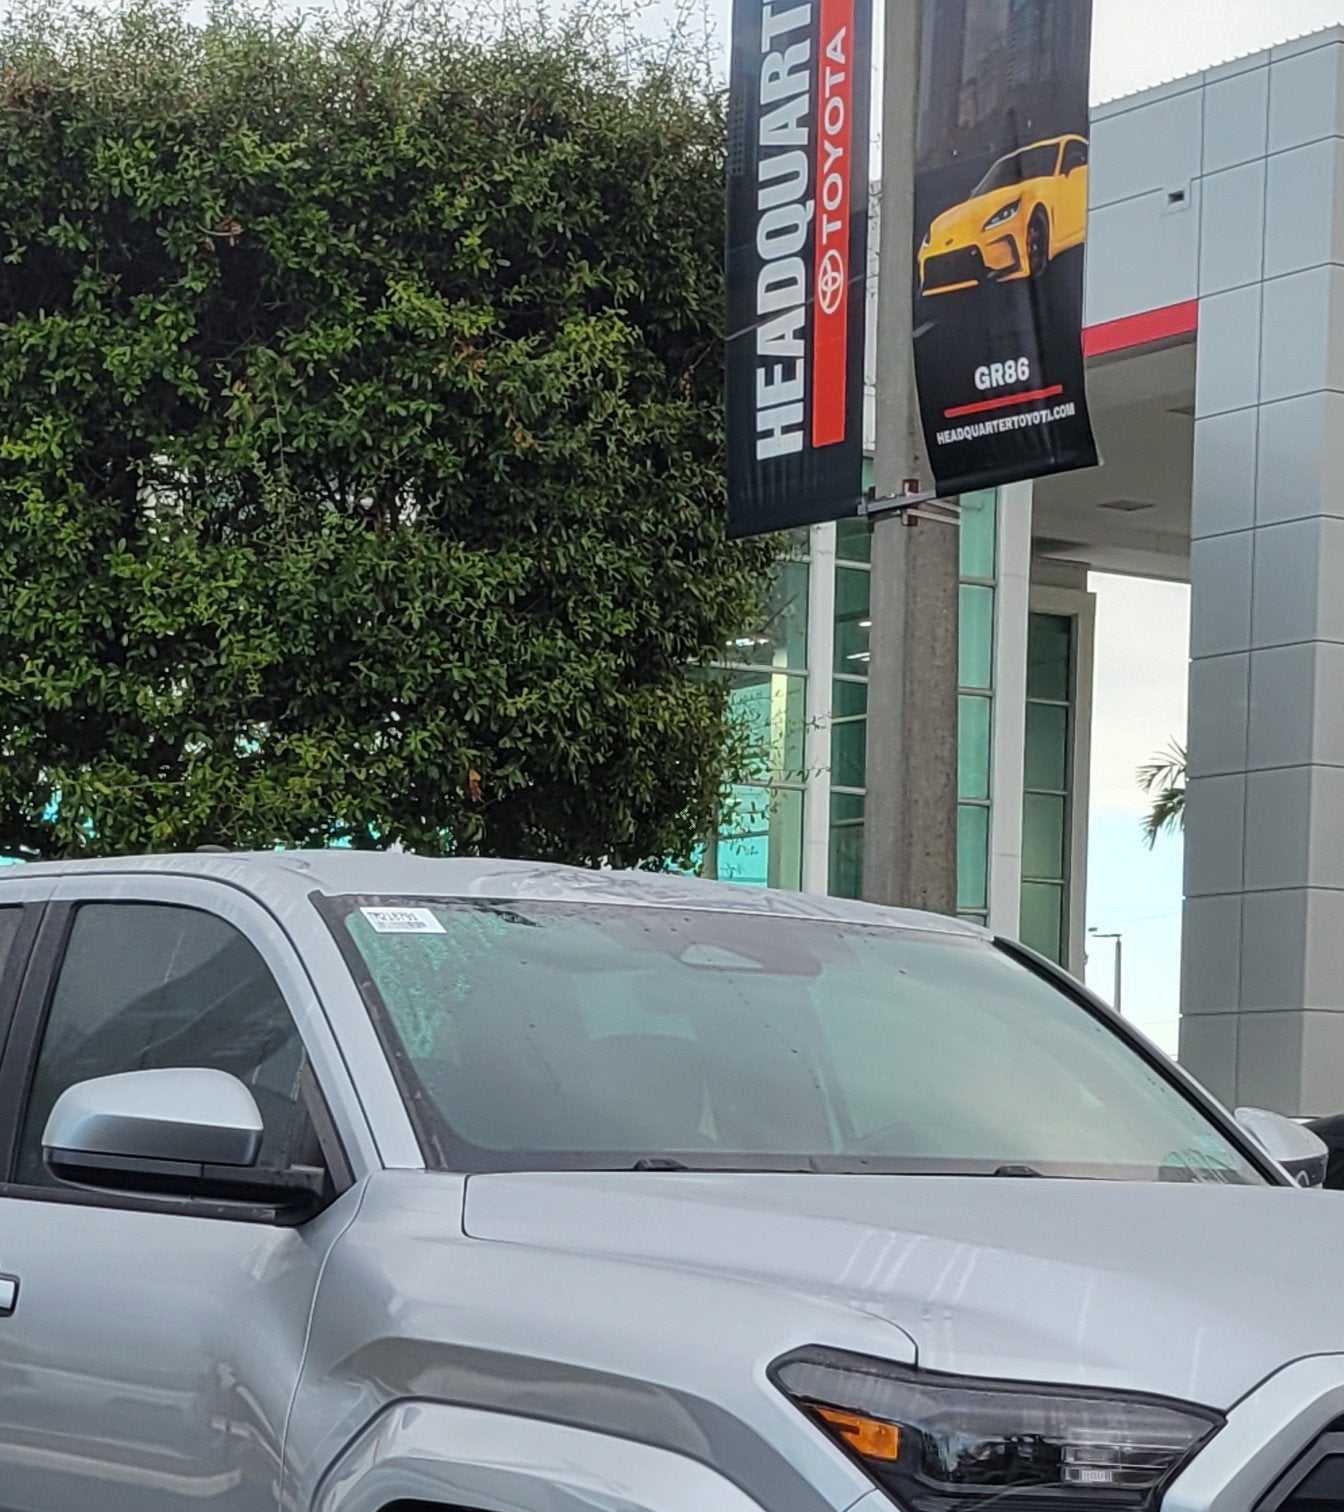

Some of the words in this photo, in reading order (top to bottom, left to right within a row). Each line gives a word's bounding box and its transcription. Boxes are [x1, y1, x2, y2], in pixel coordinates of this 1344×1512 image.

[756, 0, 814, 461] HEADQUART
[821, 26, 847, 245] TOYOTA
[974, 357, 1030, 390] GR86
